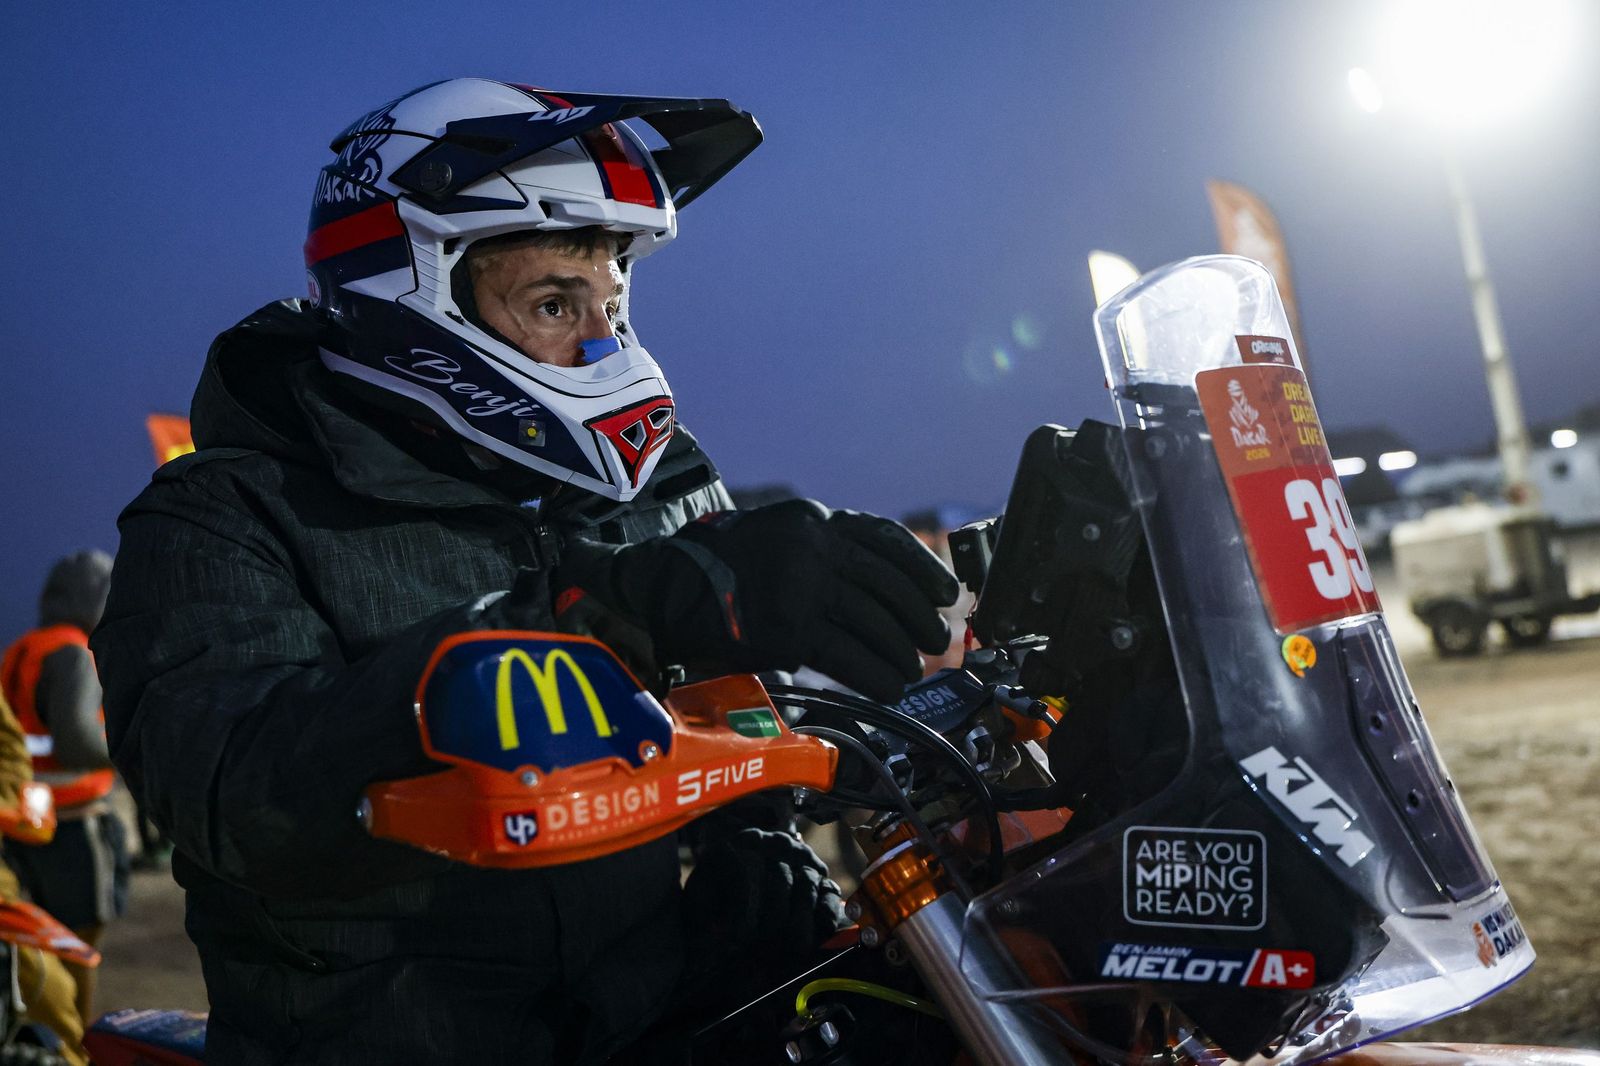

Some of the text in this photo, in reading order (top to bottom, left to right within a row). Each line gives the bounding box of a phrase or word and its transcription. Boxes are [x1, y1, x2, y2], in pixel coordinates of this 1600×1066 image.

[384, 348, 541, 416] Benji
[1284, 478, 1374, 600] 39
[705, 757, 764, 792] FIVE
[546, 781, 660, 831] DESIGN
[1239, 746, 1376, 868] KTM
[1136, 840, 1254, 865] ARE YOU
[1136, 863, 1254, 892] MiPING
[1136, 888, 1254, 919] READY?
[1111, 943, 1193, 958] BENJAMIN
